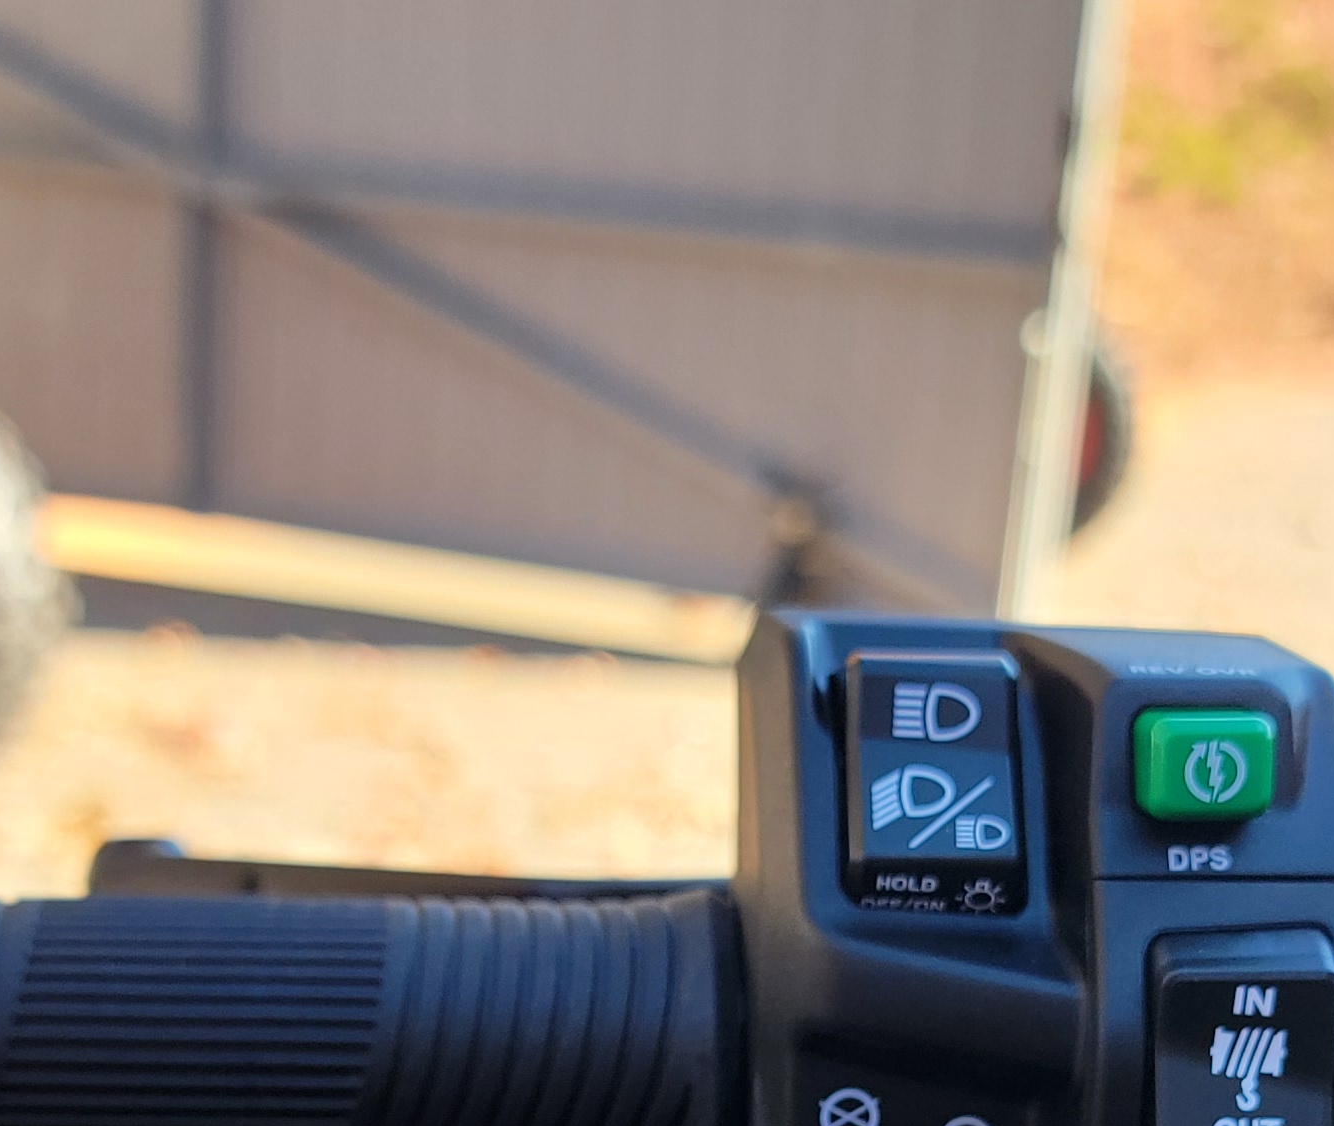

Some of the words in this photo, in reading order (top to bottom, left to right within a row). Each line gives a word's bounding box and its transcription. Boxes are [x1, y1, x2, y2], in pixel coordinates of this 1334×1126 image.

[1167, 844, 1233, 872] DPS
[875, 873, 941, 894] HOLD
[1232, 984, 1279, 1018] IN
